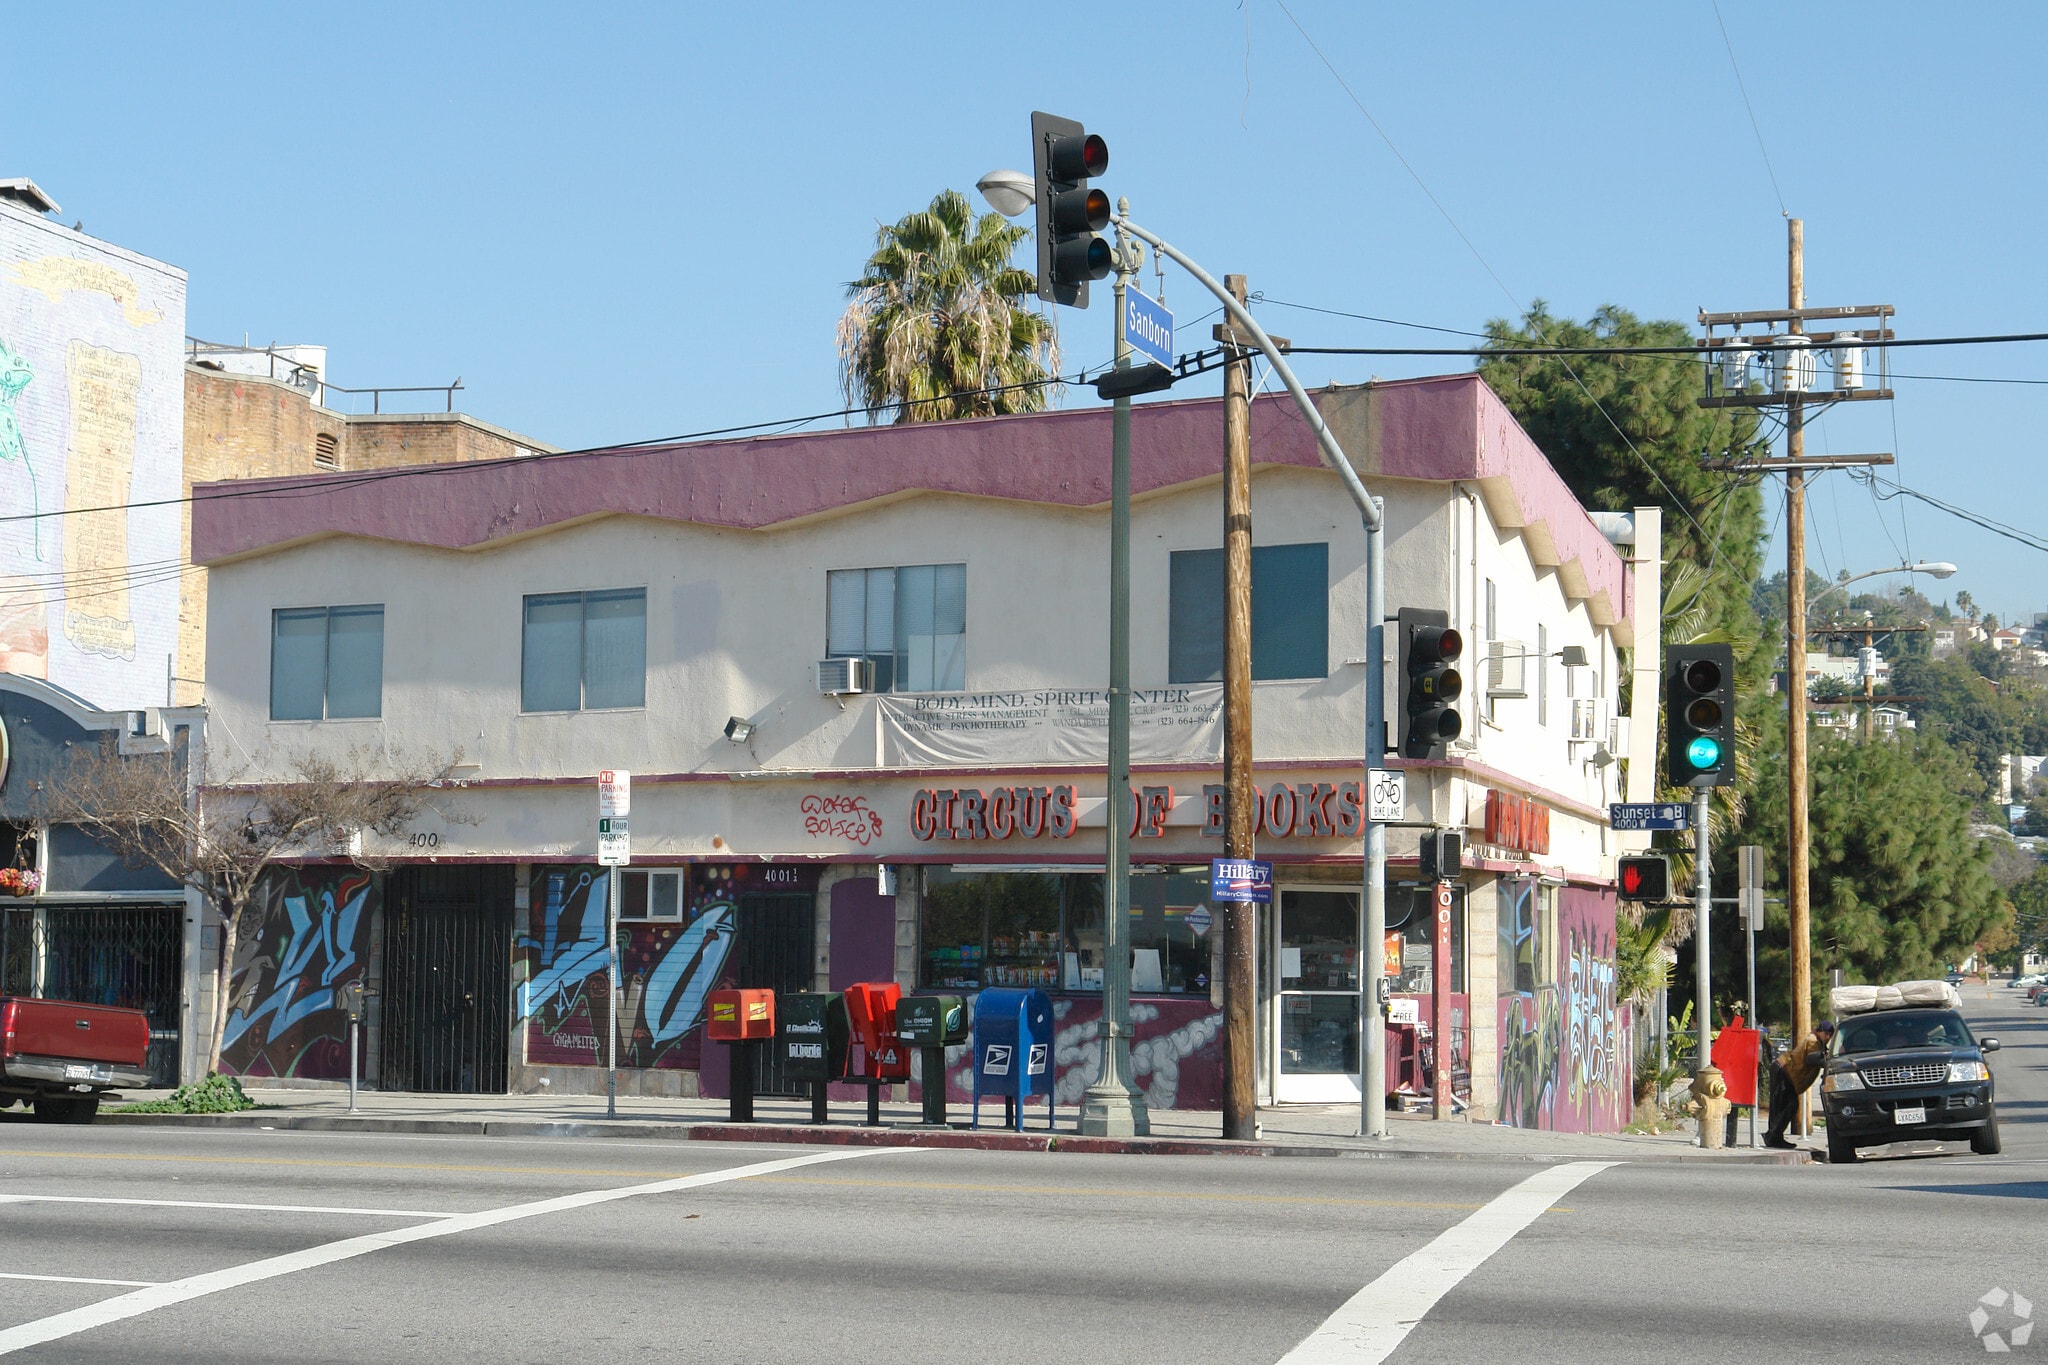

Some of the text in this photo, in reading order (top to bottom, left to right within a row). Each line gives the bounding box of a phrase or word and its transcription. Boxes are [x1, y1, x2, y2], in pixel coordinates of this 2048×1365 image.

[1129, 300, 1170, 353] Sanborn
[1033, 691, 1100, 706] SPIRIT
[1105, 689, 1190, 704] NTER
[882, 712, 942, 722] INTERACTIVE
[945, 711, 977, 721] STRESS
[981, 708, 1049, 718] MANAGEMENT
[904, 722, 944, 732] DYNAMIC
[950, 719, 1028, 731] PSYCHOTHERAPY
[602, 772, 612, 782] NO
[601, 784, 628, 793] PARKING
[910, 785, 1078, 842] CIRCUS
[1374, 806, 1401, 817] BIKE LANE
[1614, 804, 1657, 819] Sunset
[611, 821, 628, 830] HOUR
[1614, 819, 1647, 829] 4000 W
[600, 833, 628, 842] PARKING
[1217, 863, 1269, 885] Hillary
[1216, 890, 1269, 899] HillaryClinton.com
